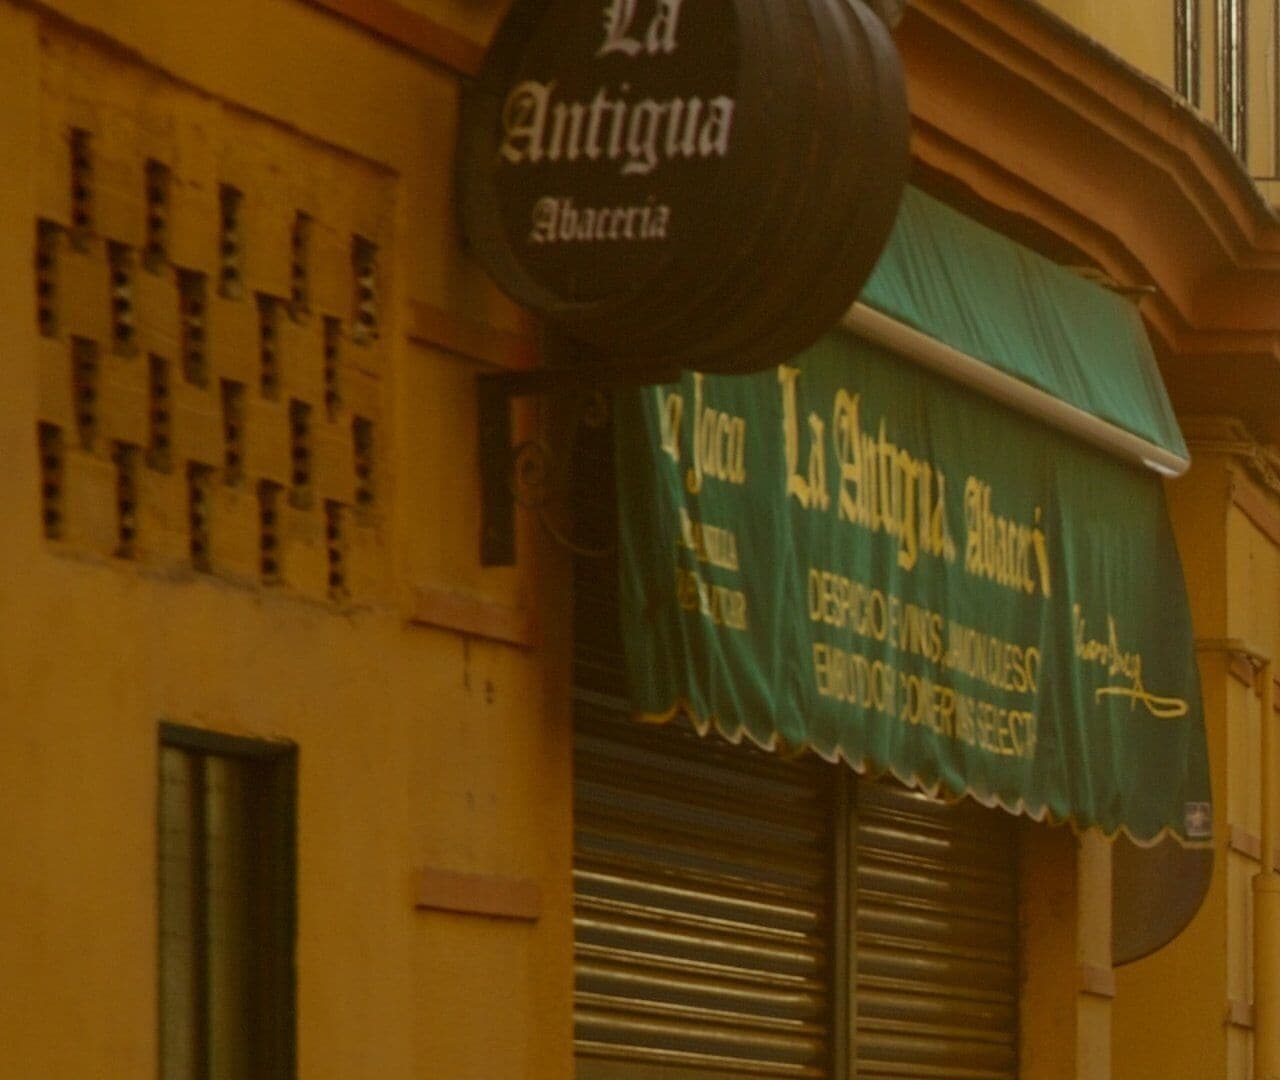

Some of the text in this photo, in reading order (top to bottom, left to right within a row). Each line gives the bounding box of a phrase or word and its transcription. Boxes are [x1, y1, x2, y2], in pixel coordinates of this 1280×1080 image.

[597, 0, 681, 55] La
[501, 80, 734, 175] Antigua
[778, 365, 829, 511] La
